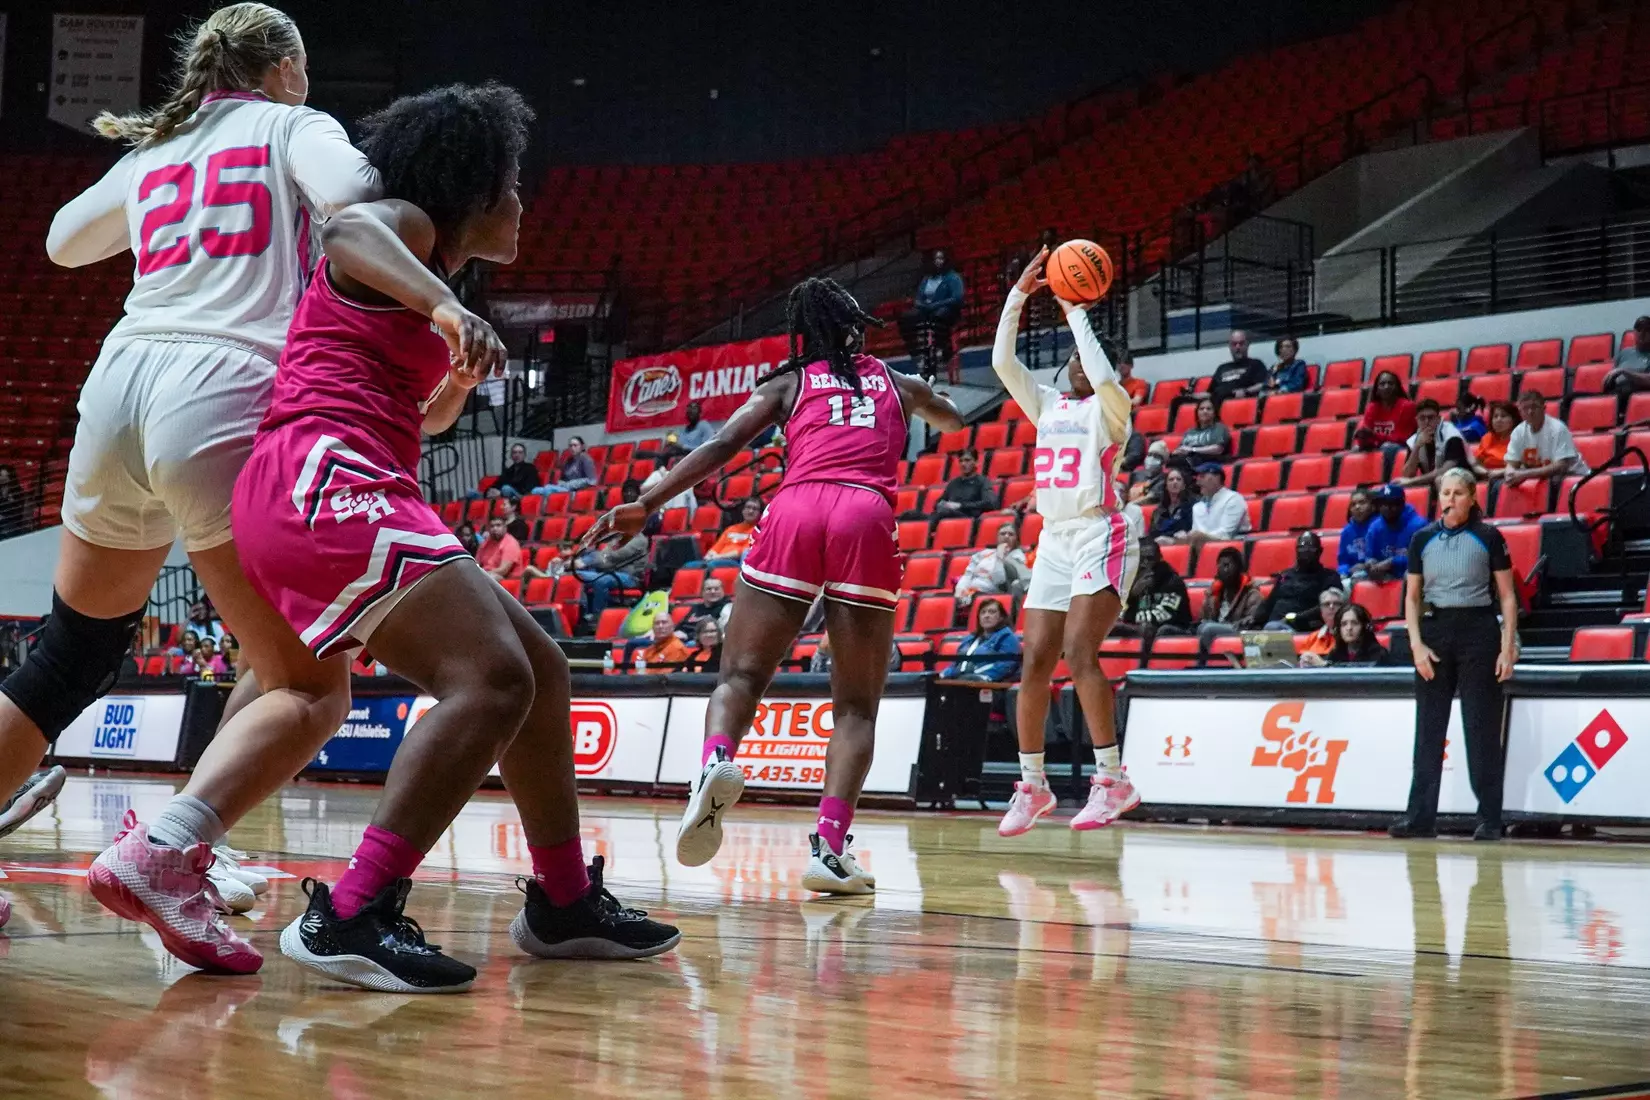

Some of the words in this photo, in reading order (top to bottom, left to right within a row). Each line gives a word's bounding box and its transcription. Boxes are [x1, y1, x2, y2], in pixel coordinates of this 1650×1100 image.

[138, 145, 272, 276] 25
[828, 395, 875, 428] 12
[1034, 447, 1081, 488] 23
[103, 704, 134, 725] BUD
[94, 727, 137, 749] LIGHT
[353, 723, 391, 738] Athletics
[750, 744, 762, 755] &
